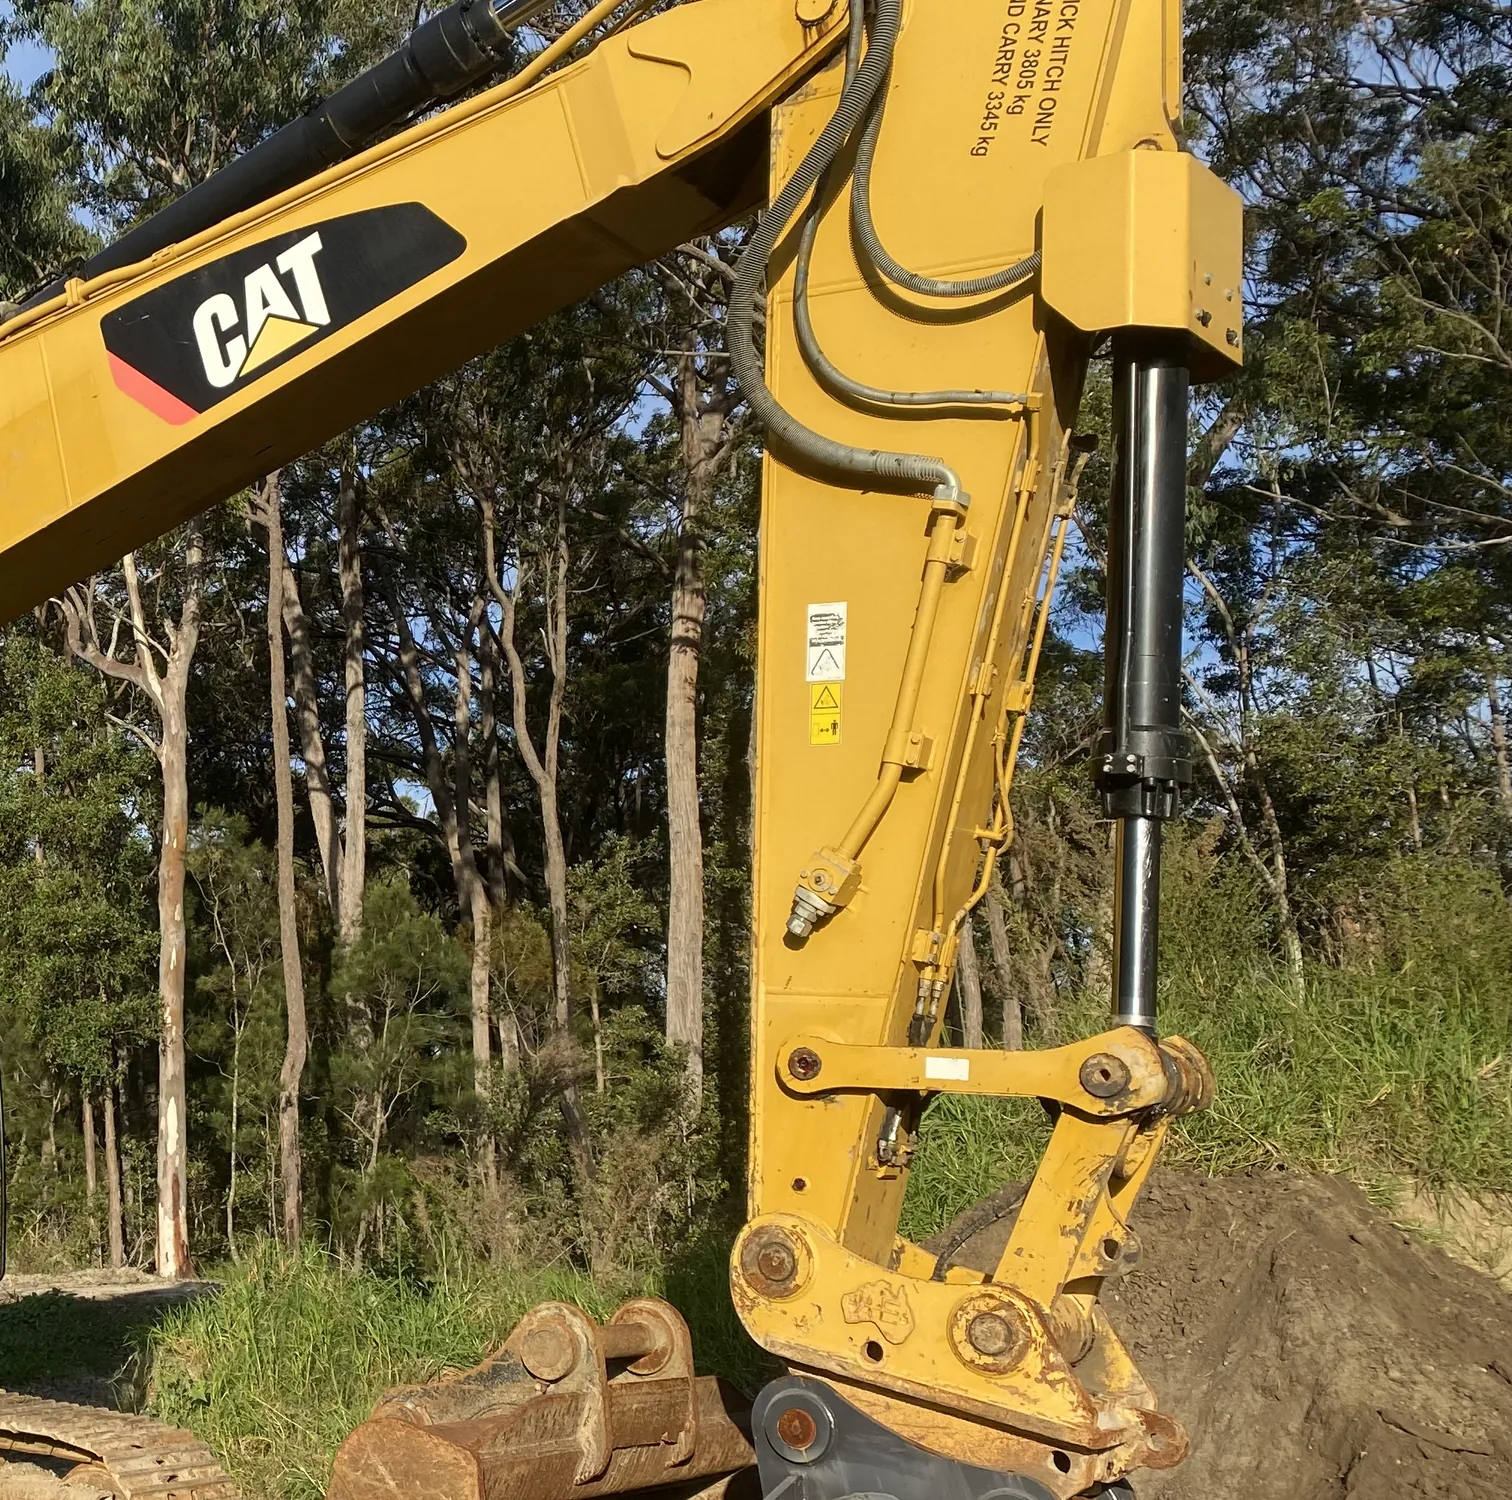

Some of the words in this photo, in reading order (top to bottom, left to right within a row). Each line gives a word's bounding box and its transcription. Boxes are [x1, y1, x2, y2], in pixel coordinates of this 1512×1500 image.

[991, 22, 1020, 86] CARRY
[1016, 49, 1041, 89] 3805
[1042, 36, 1072, 91] HITCH
[980, 91, 1005, 131] 3345
[1006, 94, 1032, 115] kg
[1030, 97, 1057, 147] ONLY
[970, 136, 995, 156] kg
[193, 231, 331, 388] CAT
